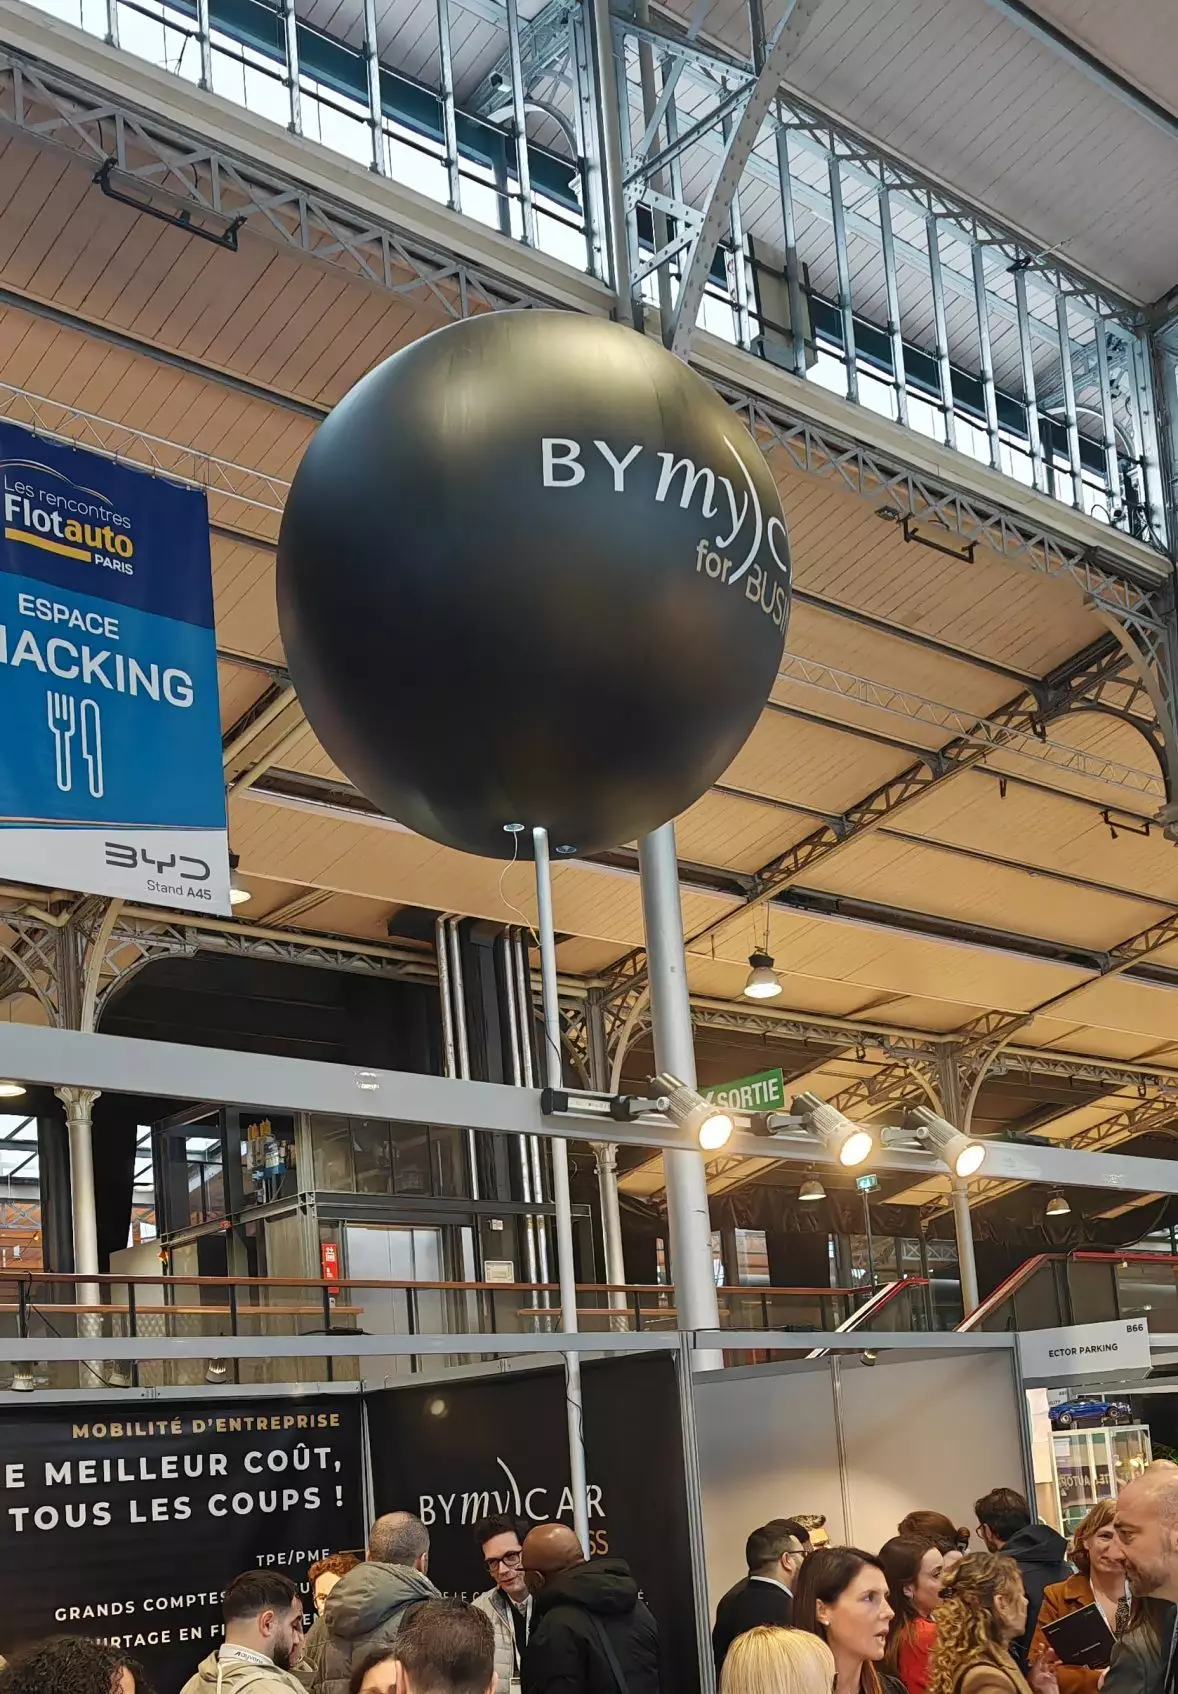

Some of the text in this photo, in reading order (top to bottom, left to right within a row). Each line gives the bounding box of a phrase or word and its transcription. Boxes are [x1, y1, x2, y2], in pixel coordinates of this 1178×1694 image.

[4, 474, 131, 529] Les rencontres
[4, 492, 134, 558] Flotauto
[94, 553, 134, 575] PARIS
[696, 539, 733, 583] for
[18, 592, 120, 640] ESPACE
[105, 841, 211, 881] BYD
[147, 879, 213, 901] Stand A45
[717, 1078, 780, 1110] SORTIE
[1126, 1323, 1144, 1333] B66
[1048, 1343, 1118, 1358] ECTOR PARKING
[72, 1416, 183, 1439] MOBILITÉ
[45, 1453, 228, 1486] MEILLEUR
[243, 1442, 341, 1474] COÛT,
[8, 1501, 112, 1532] TOUS
[129, 1496, 192, 1524] LES
[207, 1486, 321, 1517] COUPS
[256, 1548, 330, 1567] TPE/PME
[54, 1601, 135, 1622] GRANDS
[179, 1627, 202, 1641] EN
